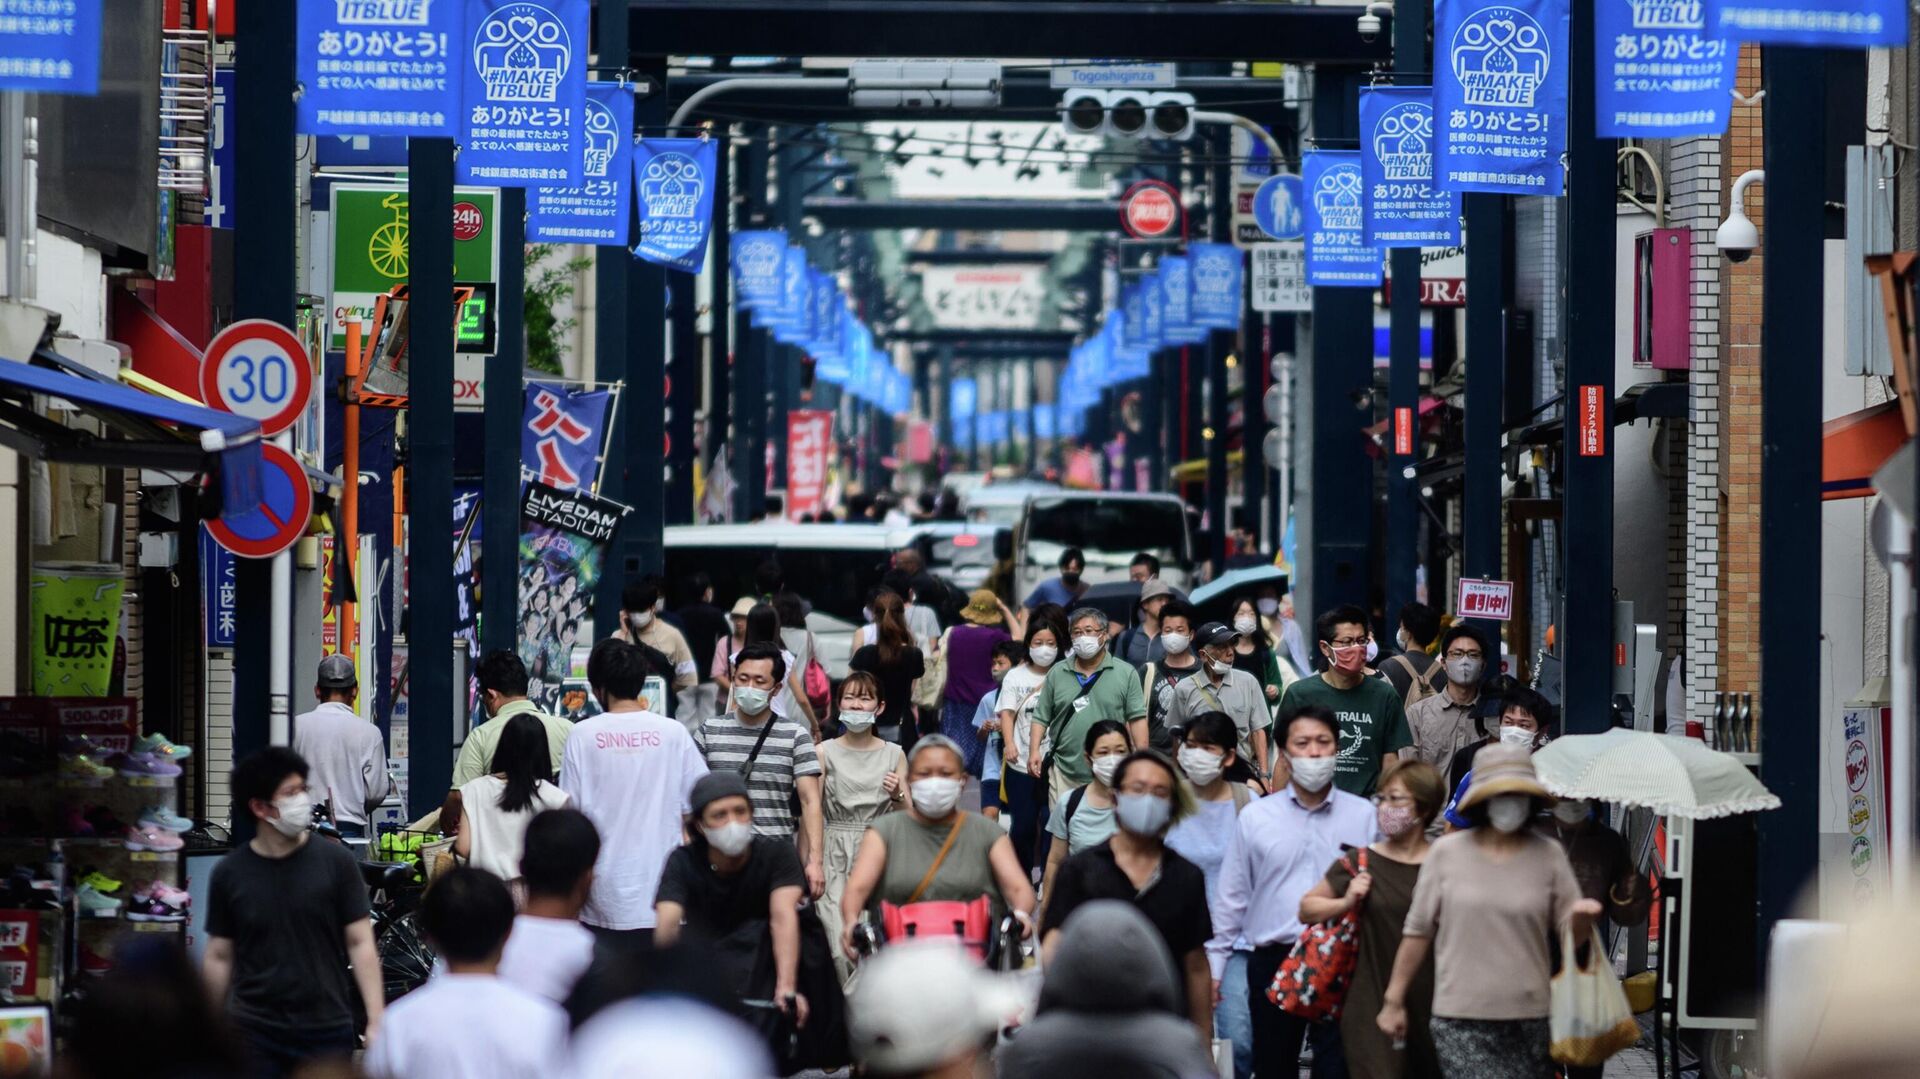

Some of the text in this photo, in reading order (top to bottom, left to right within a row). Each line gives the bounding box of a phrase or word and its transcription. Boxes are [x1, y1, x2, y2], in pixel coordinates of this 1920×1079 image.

[342, 0, 421, 20] ITBLUE
[1637, 4, 1702, 23] ITBLU
[318, 30, 447, 57] ありがとう!
[489, 69, 555, 84] #MAKE
[1071, 69, 1155, 84] Togoshiginza
[1467, 73, 1532, 89] #MAKE
[490, 84, 552, 98] ITBLUE
[1468, 88, 1530, 103] ITBLUE
[471, 105, 570, 126] ありがとう!
[1449, 109, 1549, 132] ありがとう!
[471, 128, 569, 140] 医療の最前線でたたかう
[1449, 132, 1548, 146] 医療の最前線でたたかう
[470, 141, 569, 152] 全ての人へ感謝を込めて
[1449, 145, 1548, 158] 全ての人へ感謝を込めて
[1386, 155, 1432, 166] #MAK
[470, 166, 568, 179] 戸越銀座商店街連合会
[1449, 171, 1546, 186] 戸越銀座商店街連合会
[1324, 208, 1362, 218] #MAK
[228, 355, 287, 403] 30
[1587, 387, 1597, 454] 防犯カメラ作動中
[525, 503, 612, 541] STADIUM
[595, 731, 661, 749] SINNERS
